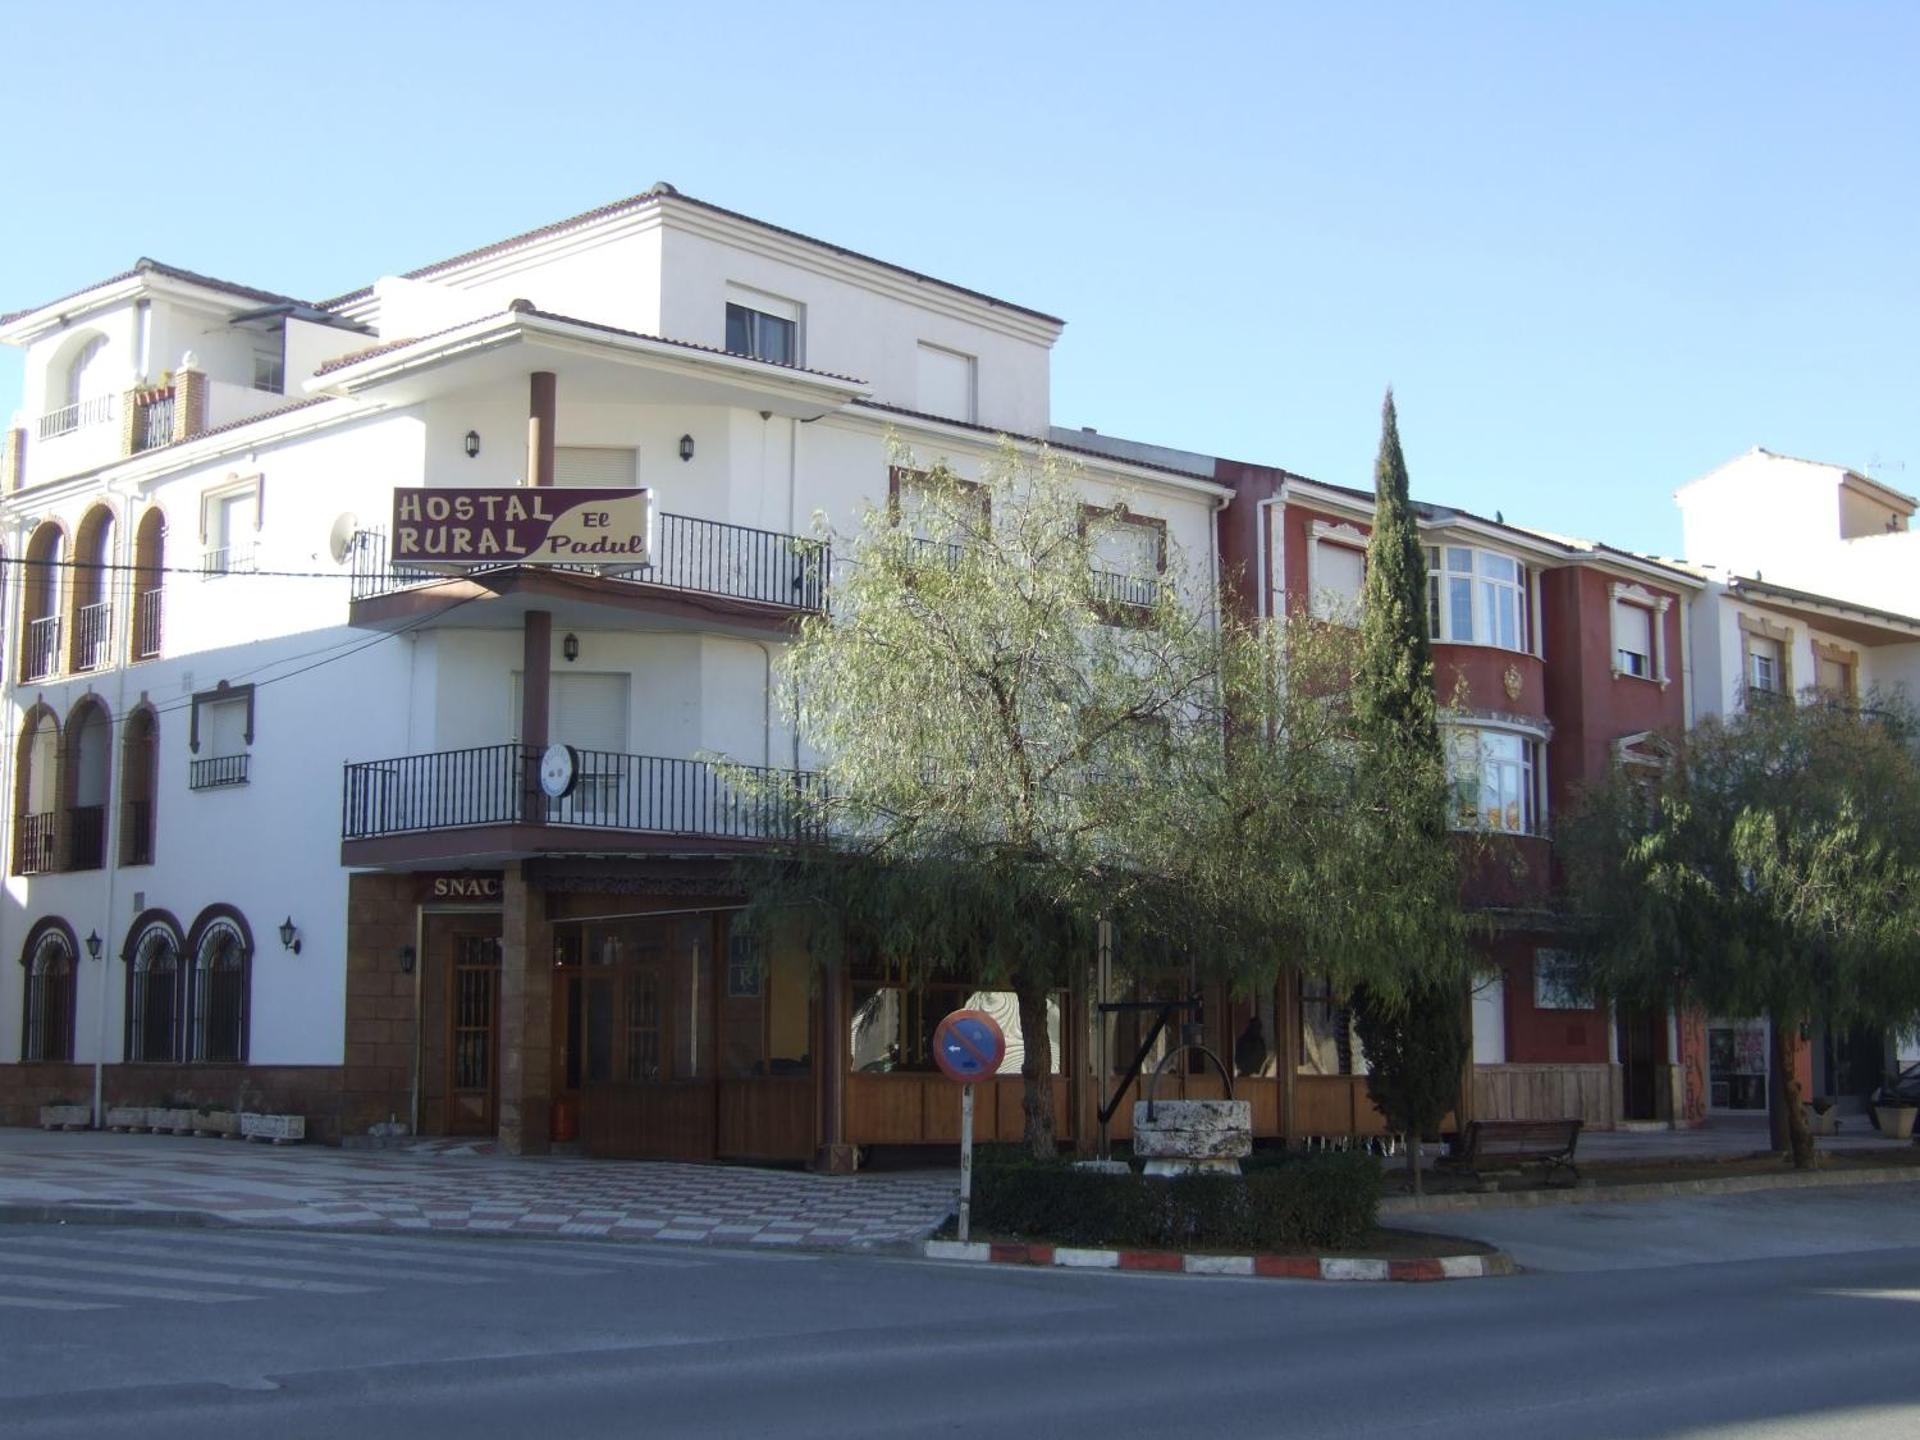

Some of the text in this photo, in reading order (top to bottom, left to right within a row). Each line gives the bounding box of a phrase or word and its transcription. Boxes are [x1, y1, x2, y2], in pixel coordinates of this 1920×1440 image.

[400, 494, 554, 522] HOSTAL
[581, 512, 611, 528] El
[399, 525, 527, 555] RURAL
[546, 534, 644, 555] Padul
